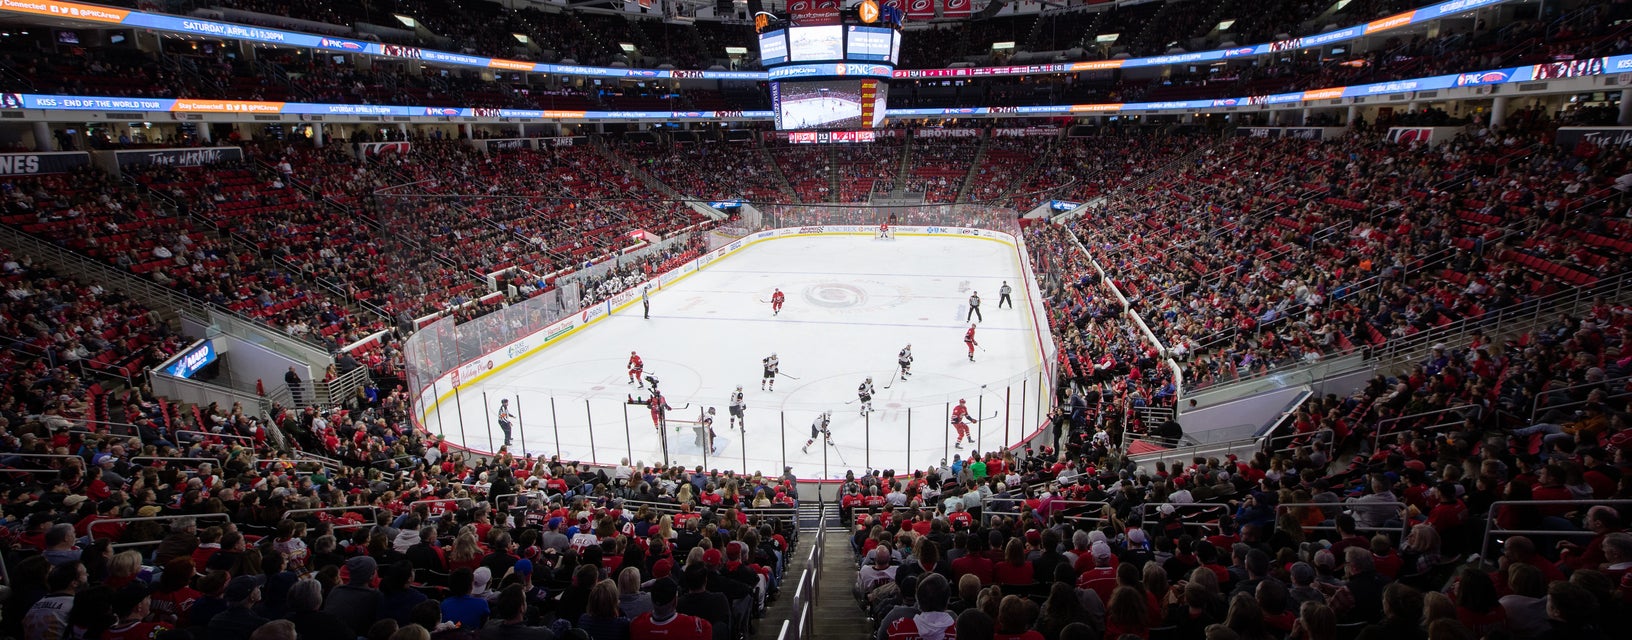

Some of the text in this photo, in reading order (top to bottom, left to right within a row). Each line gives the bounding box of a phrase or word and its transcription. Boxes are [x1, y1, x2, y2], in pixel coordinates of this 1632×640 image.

[183, 21, 227, 35] SATURDAY,
[260, 31, 284, 41] 7:30PM
[848, 65, 869, 75] PNC
[1464, 73, 1482, 84] PNC
[64, 99, 82, 107] END
[112, 100, 139, 108] WORLD
[919, 129, 977, 138] BROTHERS
[995, 128, 1025, 137] ZONE
[179, 149, 223, 167] WARNING
[0, 155, 39, 174] NES
[589, 307, 603, 318] pepsi
[187, 345, 209, 367] MAKO
